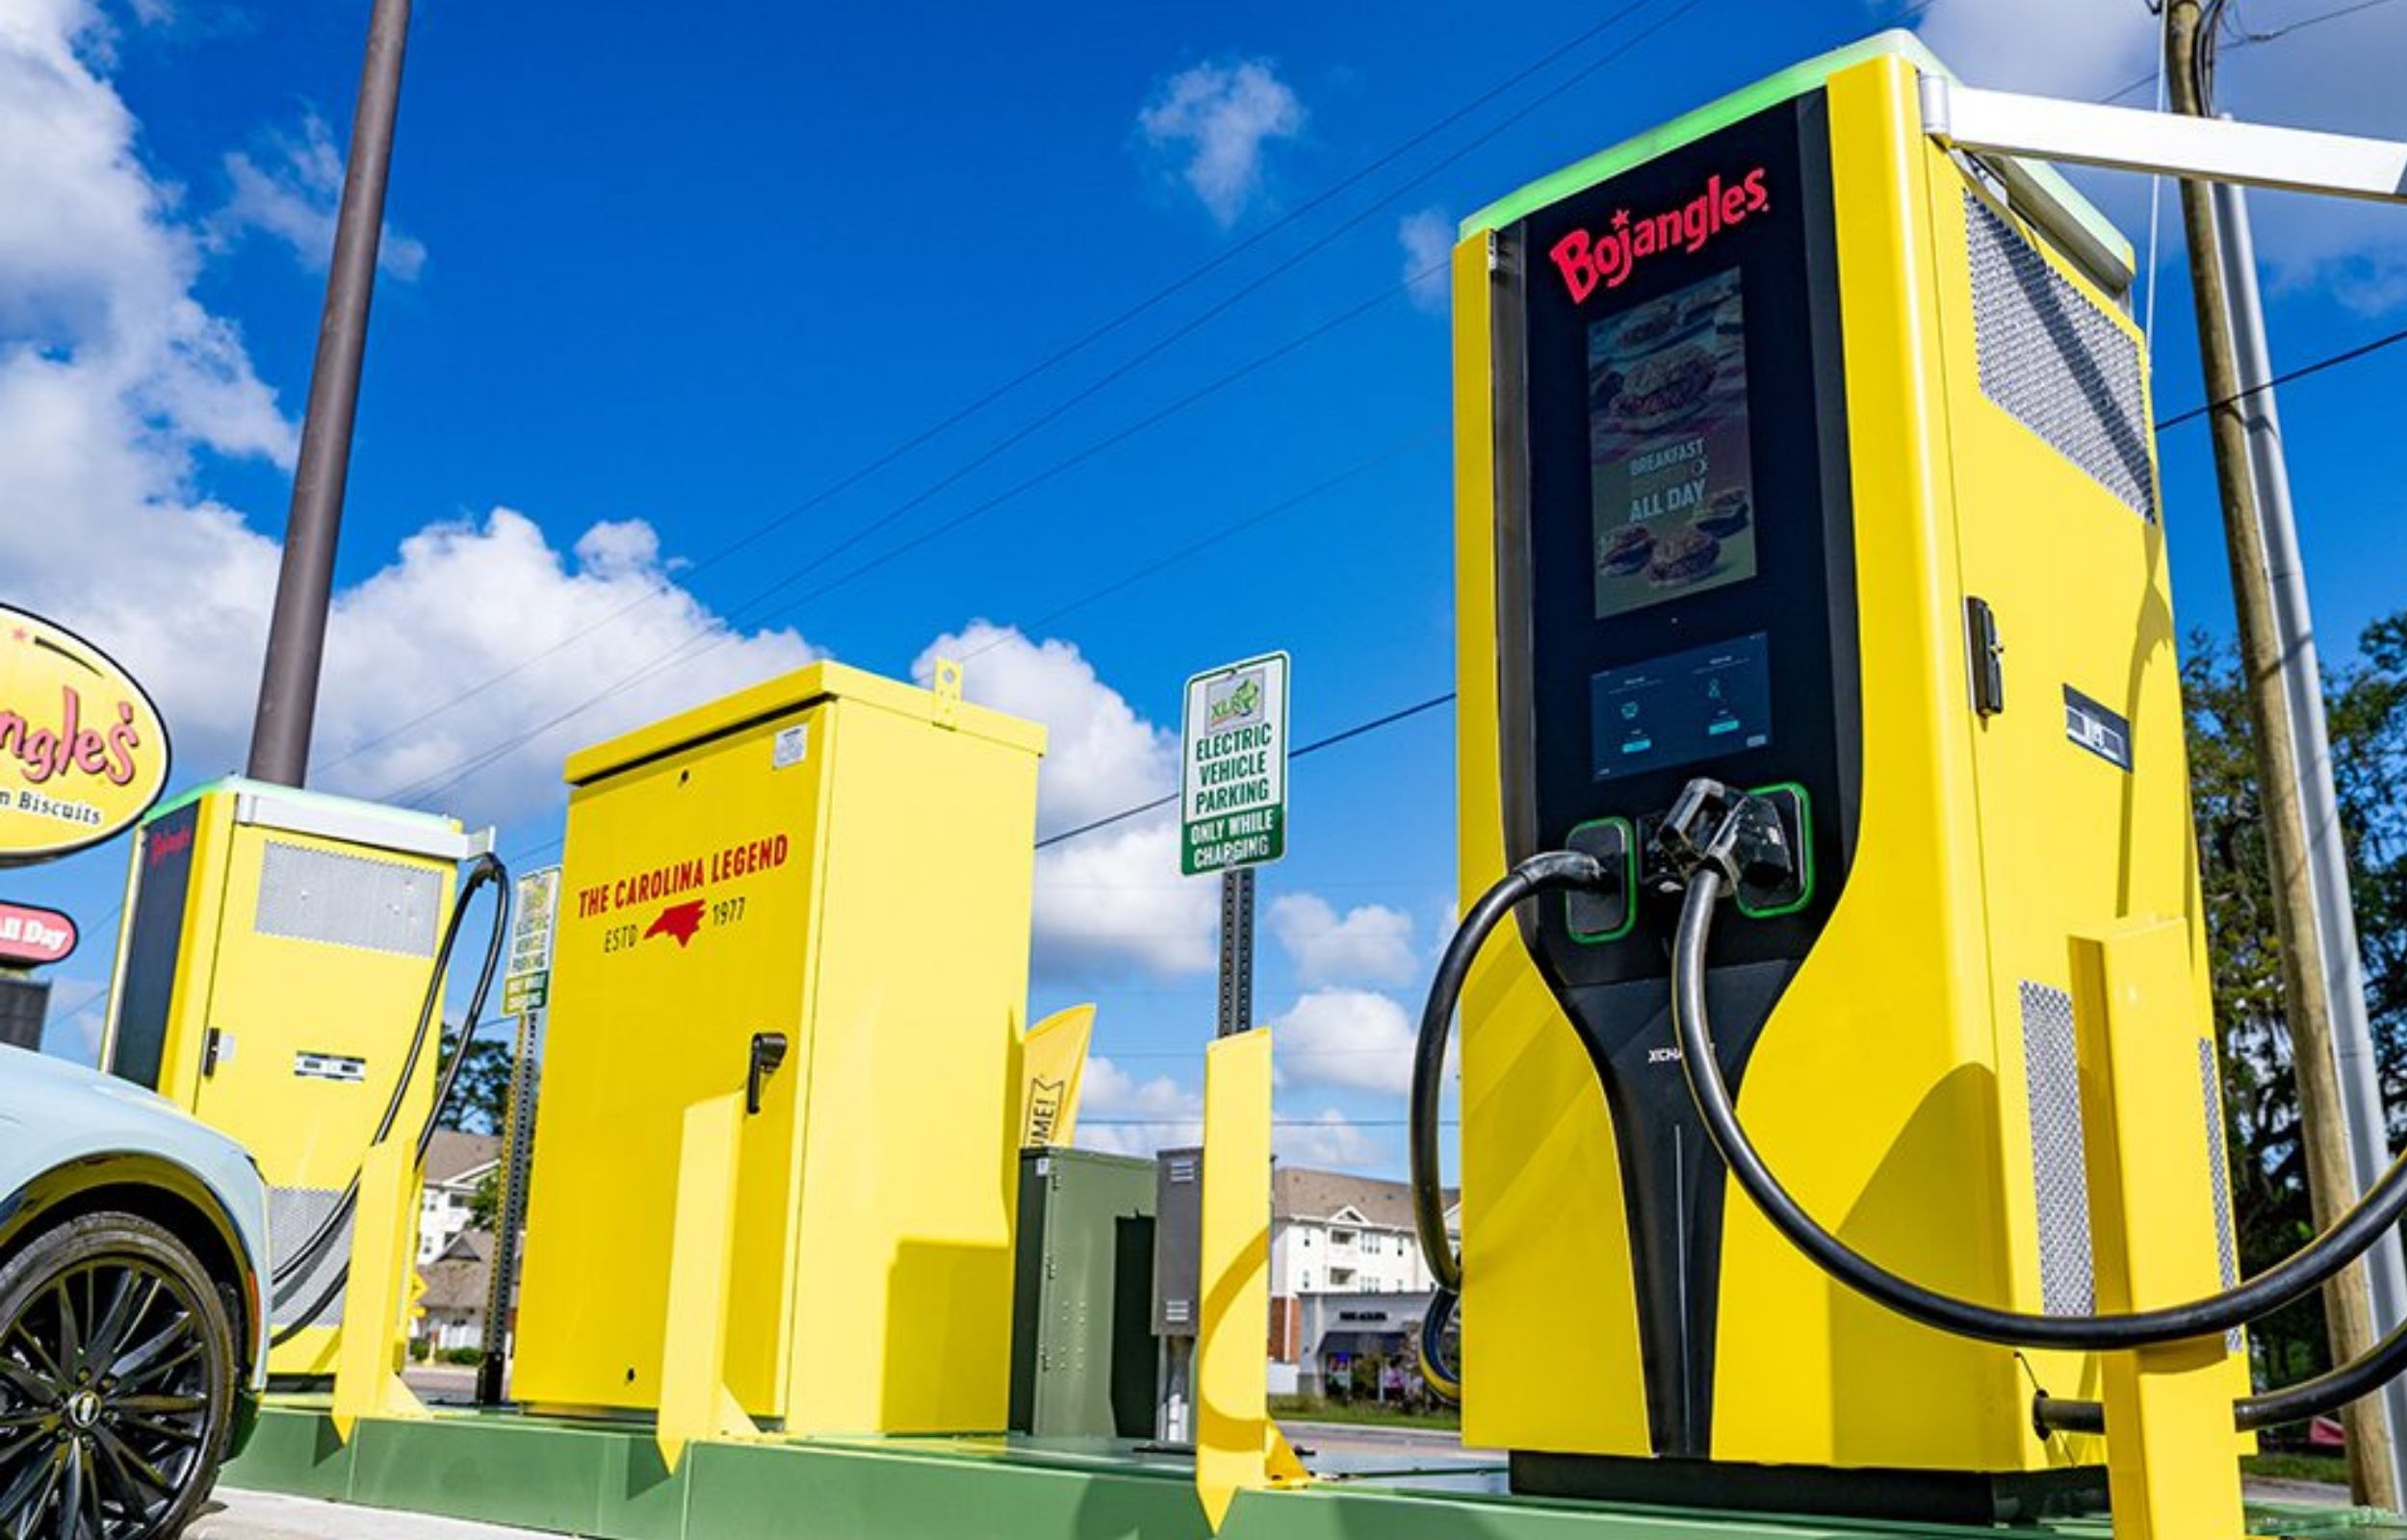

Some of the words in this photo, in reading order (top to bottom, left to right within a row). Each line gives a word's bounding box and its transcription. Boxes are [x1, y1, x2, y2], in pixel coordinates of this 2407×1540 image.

[1549, 167, 1768, 305] Bojangles
[1630, 438, 1703, 476] BREAKFAST
[1629, 493, 1664, 524] ALL
[1668, 478, 1706, 511] DAY
[1196, 723, 1272, 762] ELECTRIC
[1200, 751, 1266, 787] VEHICLE
[18, 790, 101, 825] Biscuits
[1196, 778, 1269, 815] PARKING
[1191, 819, 1225, 845] ONLY
[1229, 808, 1274, 835] WHILE
[1194, 834, 1270, 869] CHARGING
[579, 885, 609, 918] THE
[614, 857, 705, 910] CAROLINA
[711, 834, 788, 884] LEGEND
[21, 919, 67, 951] Day
[604, 924, 637, 953] ESTD
[712, 896, 745, 926] 1977
